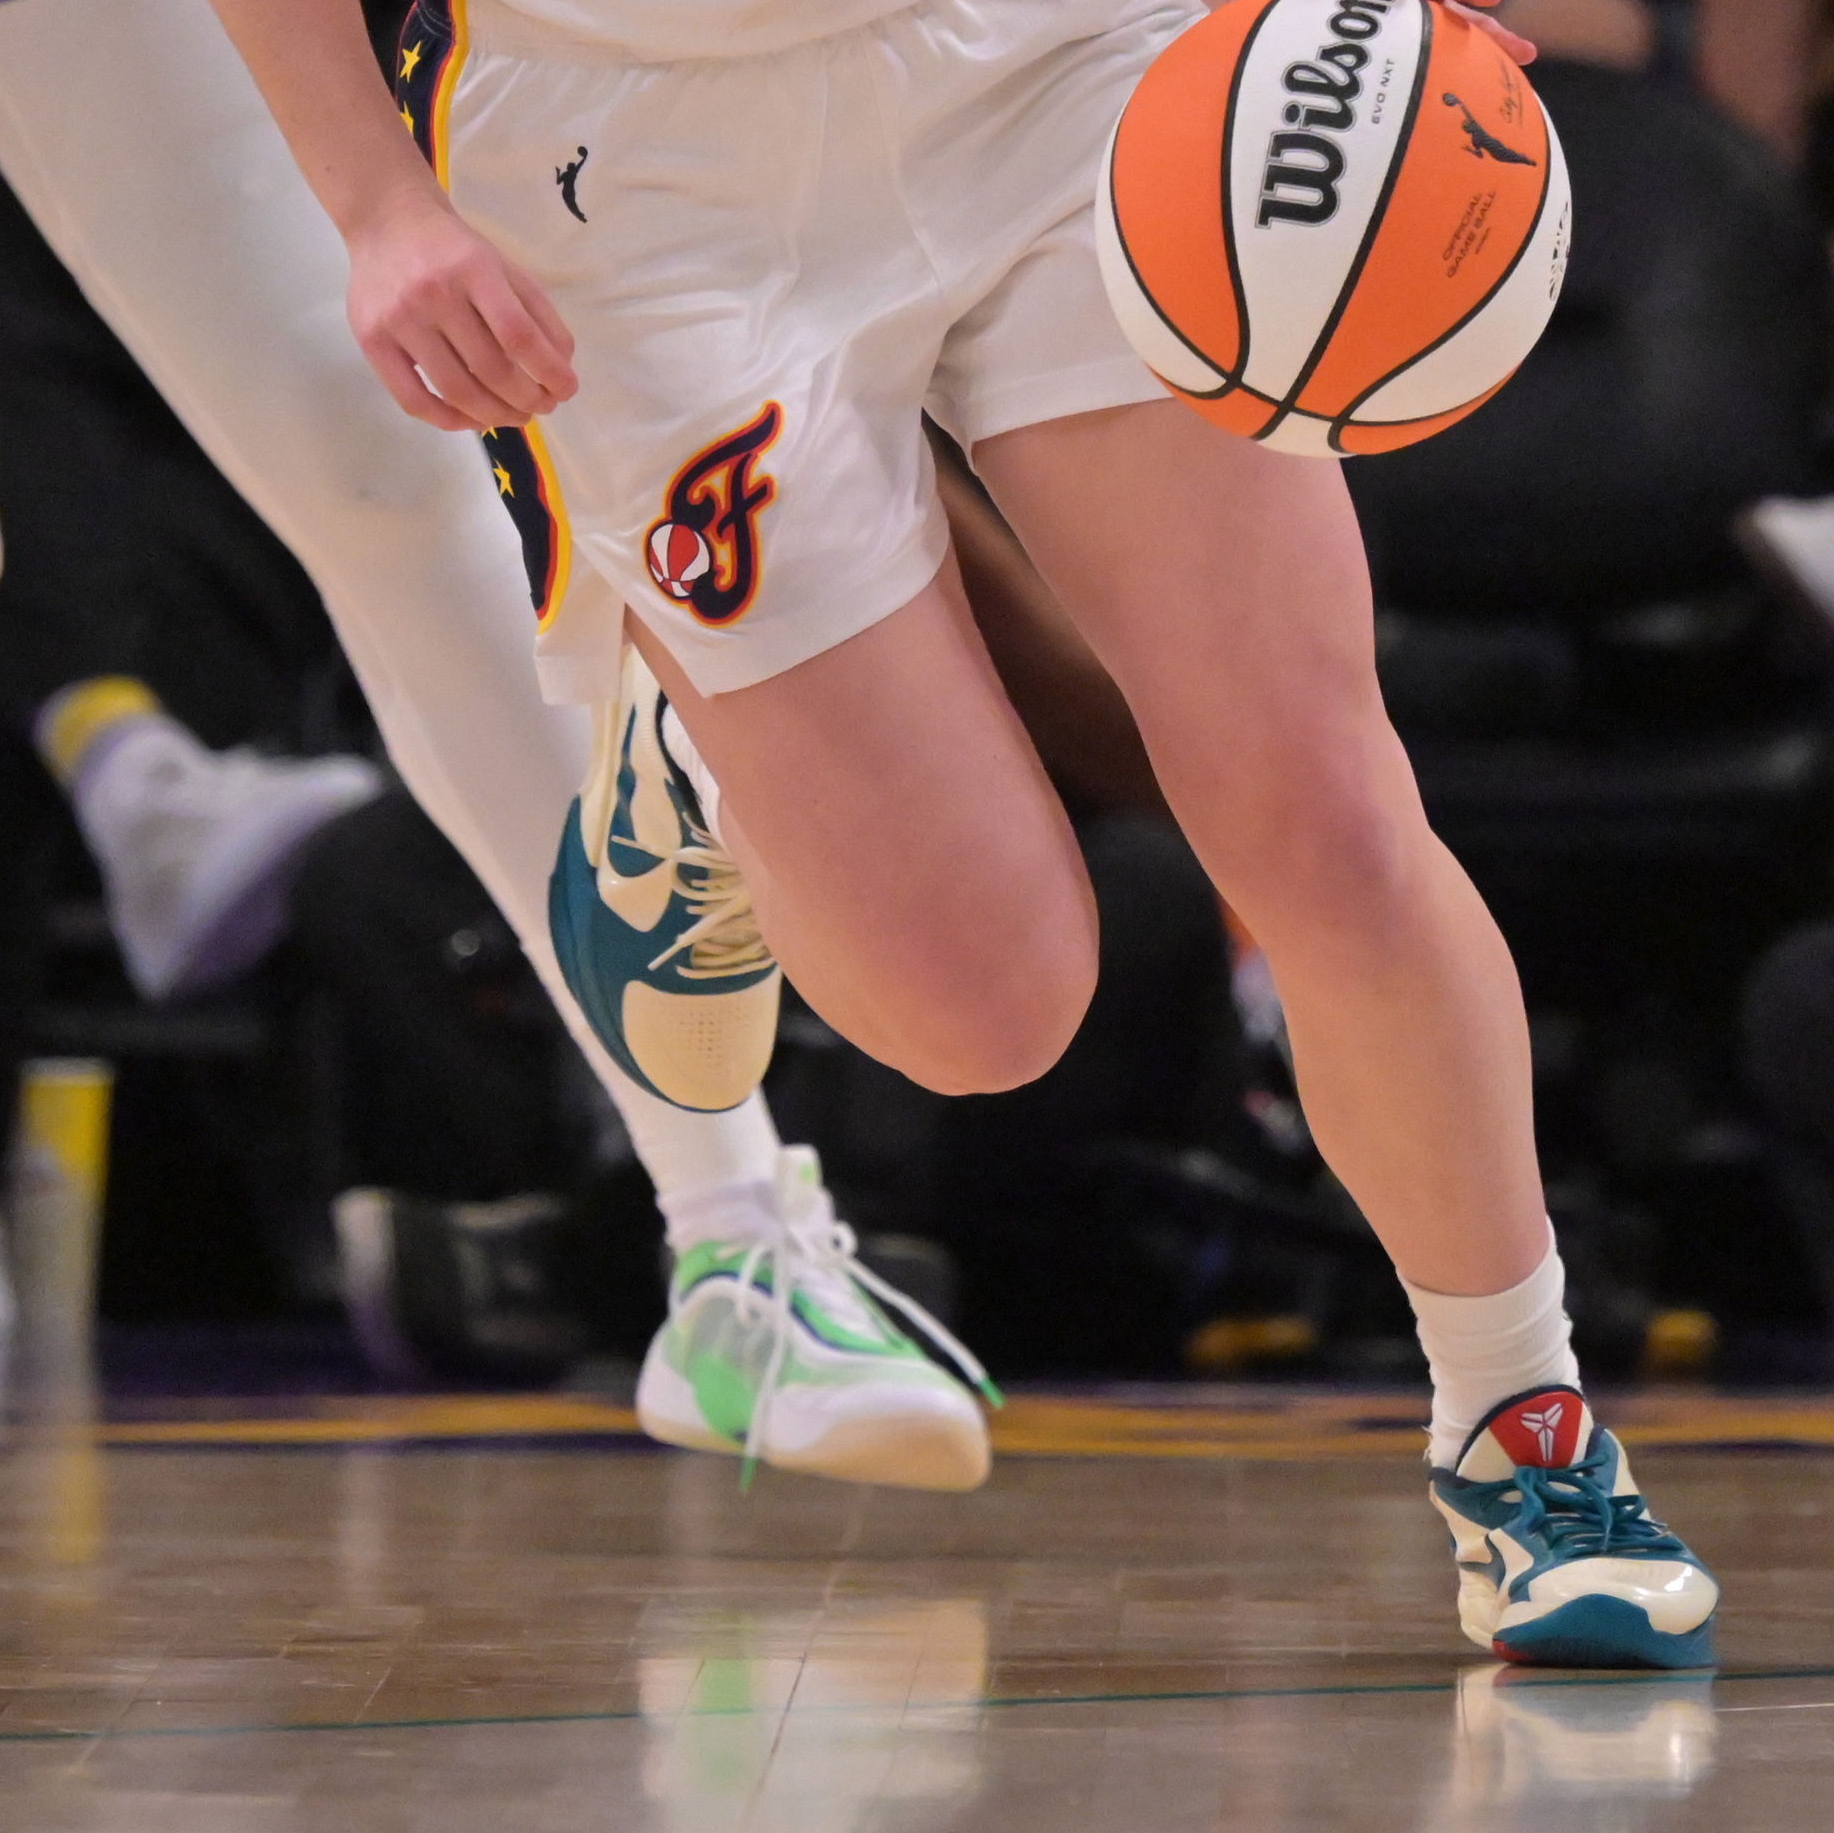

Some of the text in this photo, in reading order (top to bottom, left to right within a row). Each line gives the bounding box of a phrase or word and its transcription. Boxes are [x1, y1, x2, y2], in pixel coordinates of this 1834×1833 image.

[1371, 58, 1395, 125] EVO NXT
[1442, 192, 1482, 262] OFFICIAL
[1446, 232, 1476, 279] GAME
[1473, 190, 1497, 229] BALL
